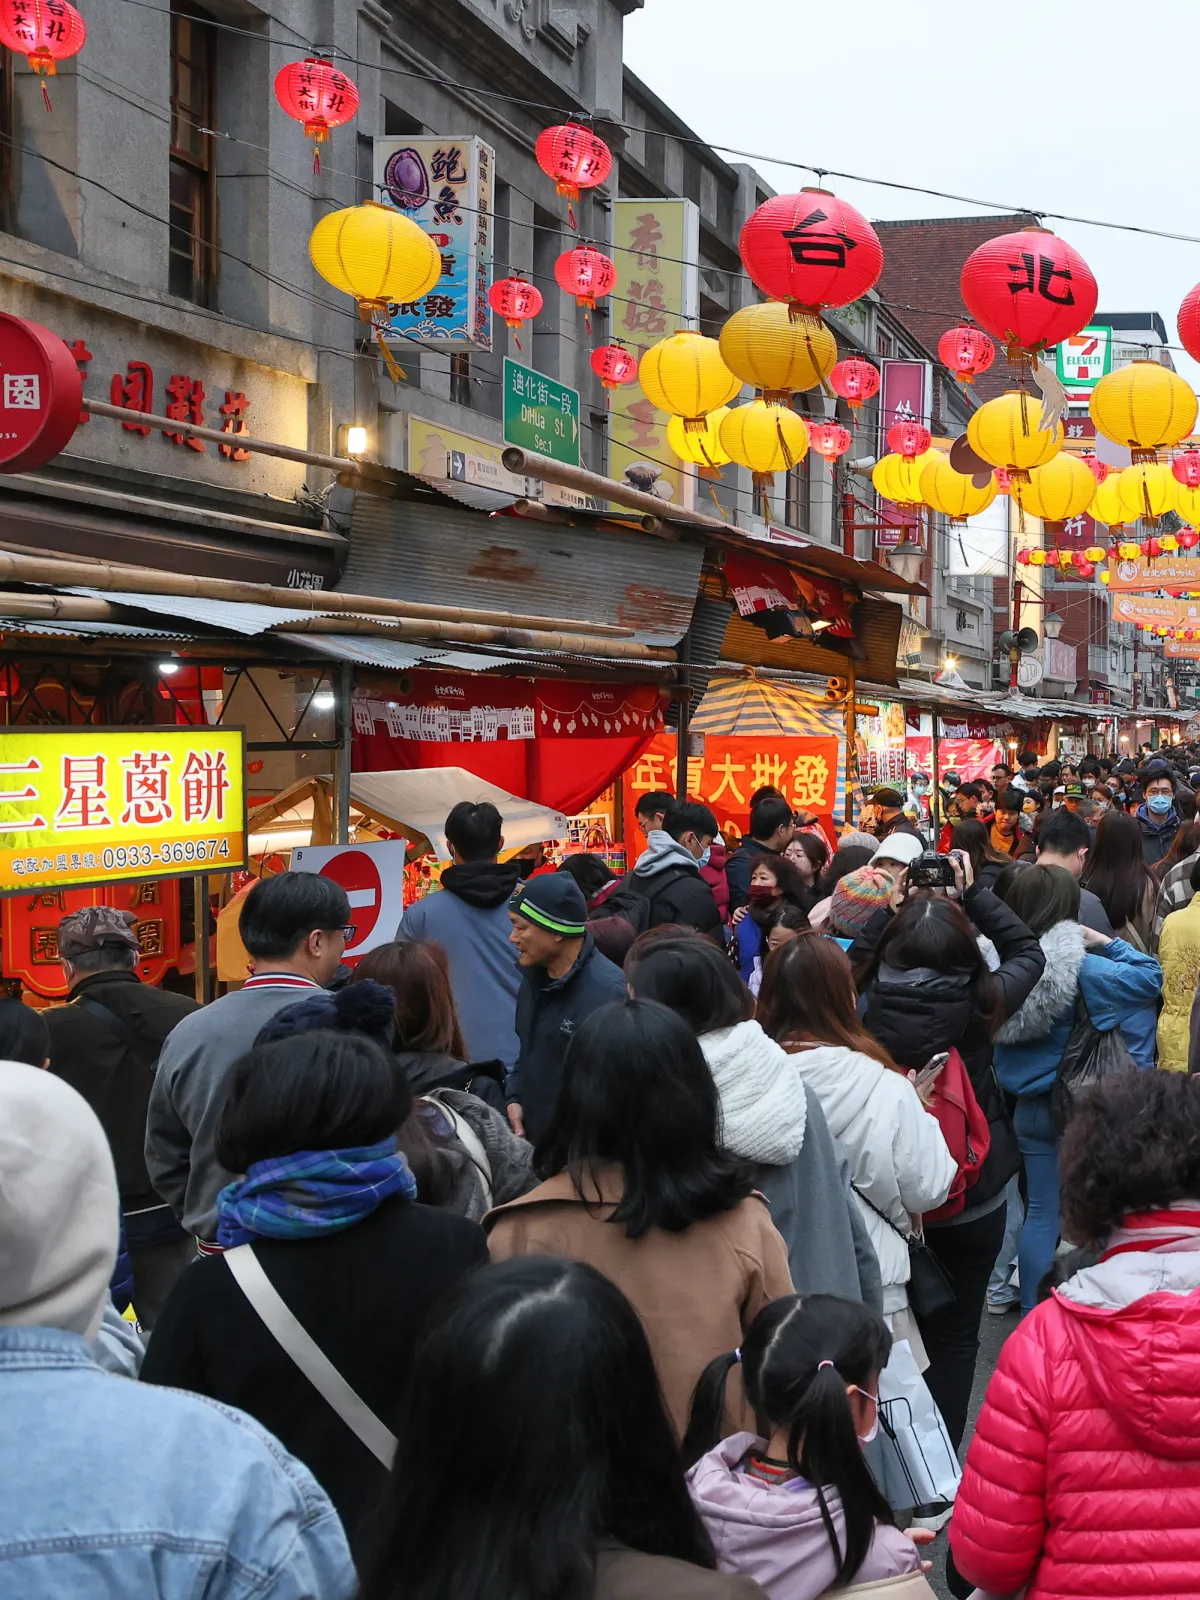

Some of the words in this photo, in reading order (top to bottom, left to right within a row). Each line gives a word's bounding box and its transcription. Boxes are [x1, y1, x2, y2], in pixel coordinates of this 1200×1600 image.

[327, 73, 349, 113] 台北
[430, 147, 468, 226] 鮑魚
[782, 207, 858, 268] 台
[1007, 252, 1076, 306] 北
[512, 368, 573, 418] 迪化街一段
[521, 403, 546, 430] DiHua
[554, 417, 567, 438] St.
[534, 435, 553, 454] Sec.1
[0, 751, 231, 833] 三星蔥餅
[631, 752, 830, 806] 年貨大批發
[102, 837, 230, 870] 0933-369674
